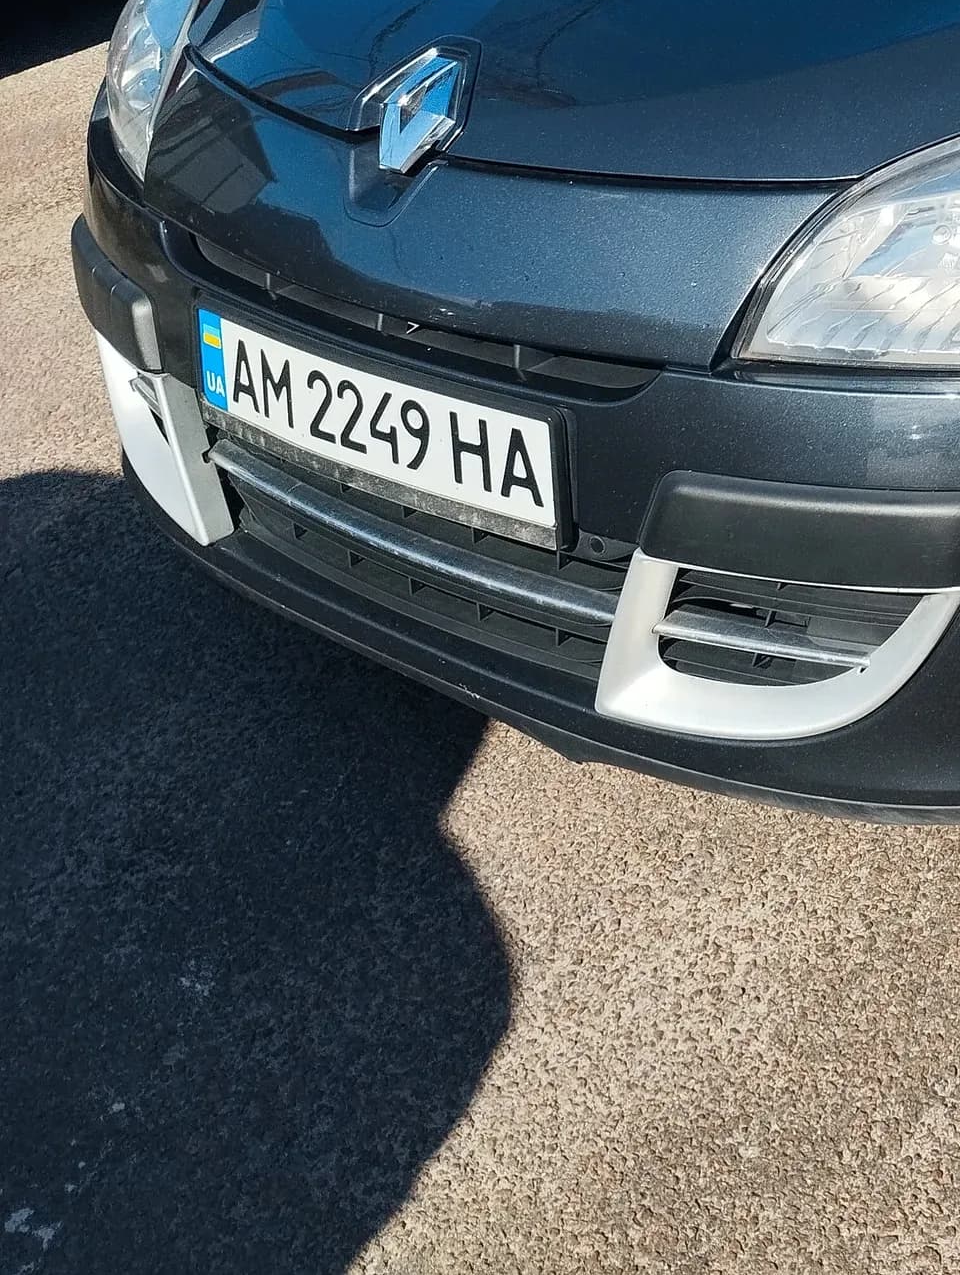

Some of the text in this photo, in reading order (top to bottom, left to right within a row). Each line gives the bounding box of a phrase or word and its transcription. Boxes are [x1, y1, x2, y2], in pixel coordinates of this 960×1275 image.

[206, 370, 226, 397] UA
[232, 339, 545, 507] AM 2249 HA
